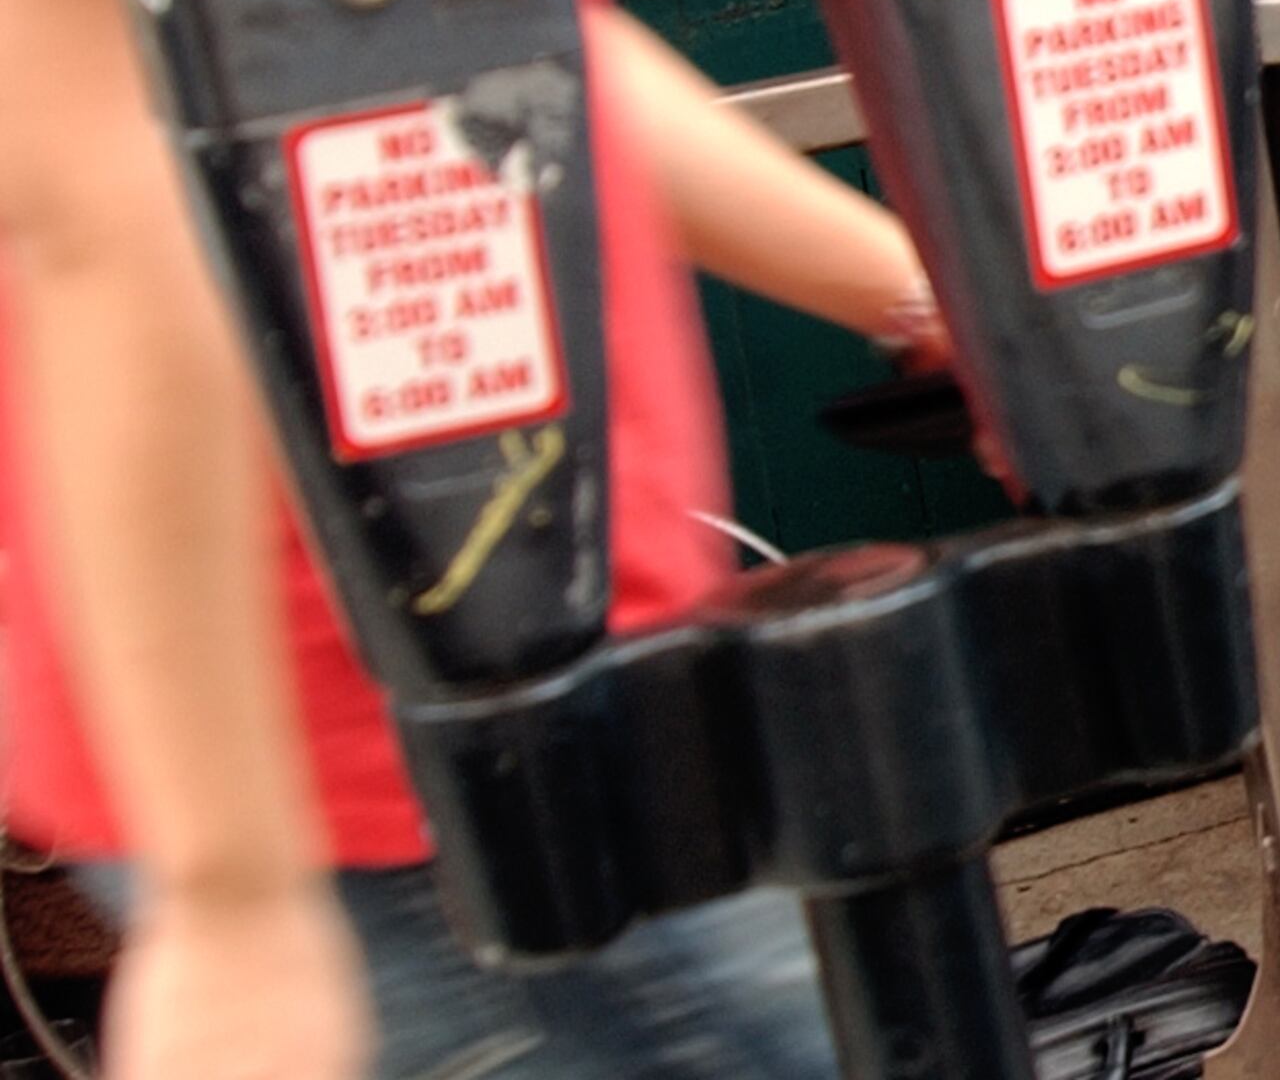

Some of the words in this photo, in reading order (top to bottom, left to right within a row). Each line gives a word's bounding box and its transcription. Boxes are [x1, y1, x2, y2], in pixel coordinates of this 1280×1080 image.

[1026, 1, 1184, 56] PARKING
[1031, 42, 1188, 96] TUESDAY
[1062, 86, 1169, 130] FROM
[381, 131, 433, 158] NO
[1107, 169, 1150, 197] TO
[331, 200, 509, 253] TUESDAY
[366, 248, 487, 291] FROM
[419, 335, 468, 364] TO
